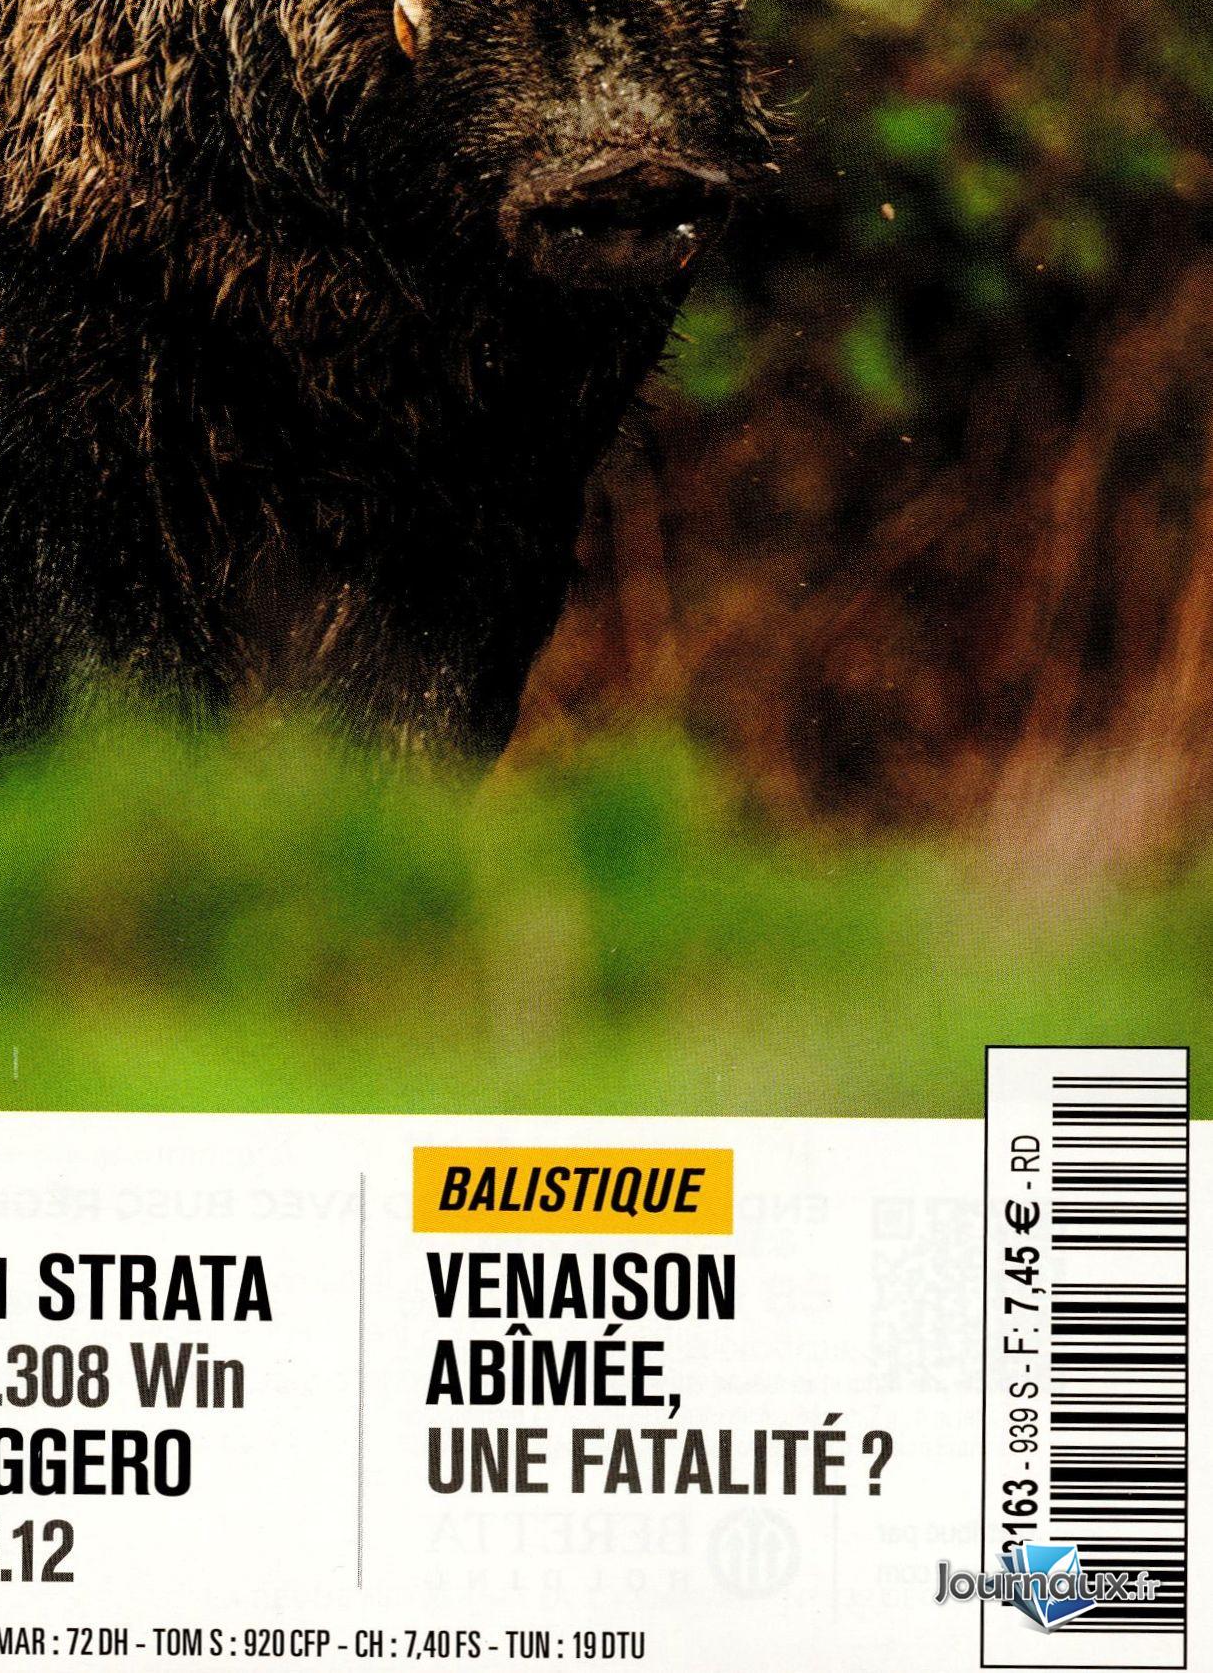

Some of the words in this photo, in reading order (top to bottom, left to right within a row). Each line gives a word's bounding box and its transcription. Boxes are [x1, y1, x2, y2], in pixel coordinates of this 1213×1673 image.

[1011, 1135, 1040, 1172] RD
[439, 1167, 705, 1217] BALISTIQUE
[38, 1253, 273, 1322] STRATA
[426, 1252, 736, 1320] VENAISON
[131, 1343, 245, 1409] Win
[426, 1324, 682, 1419] ABÎMÉE,
[429, 1428, 548, 1494] UNE
[1009, 1408, 1039, 1453] 939
